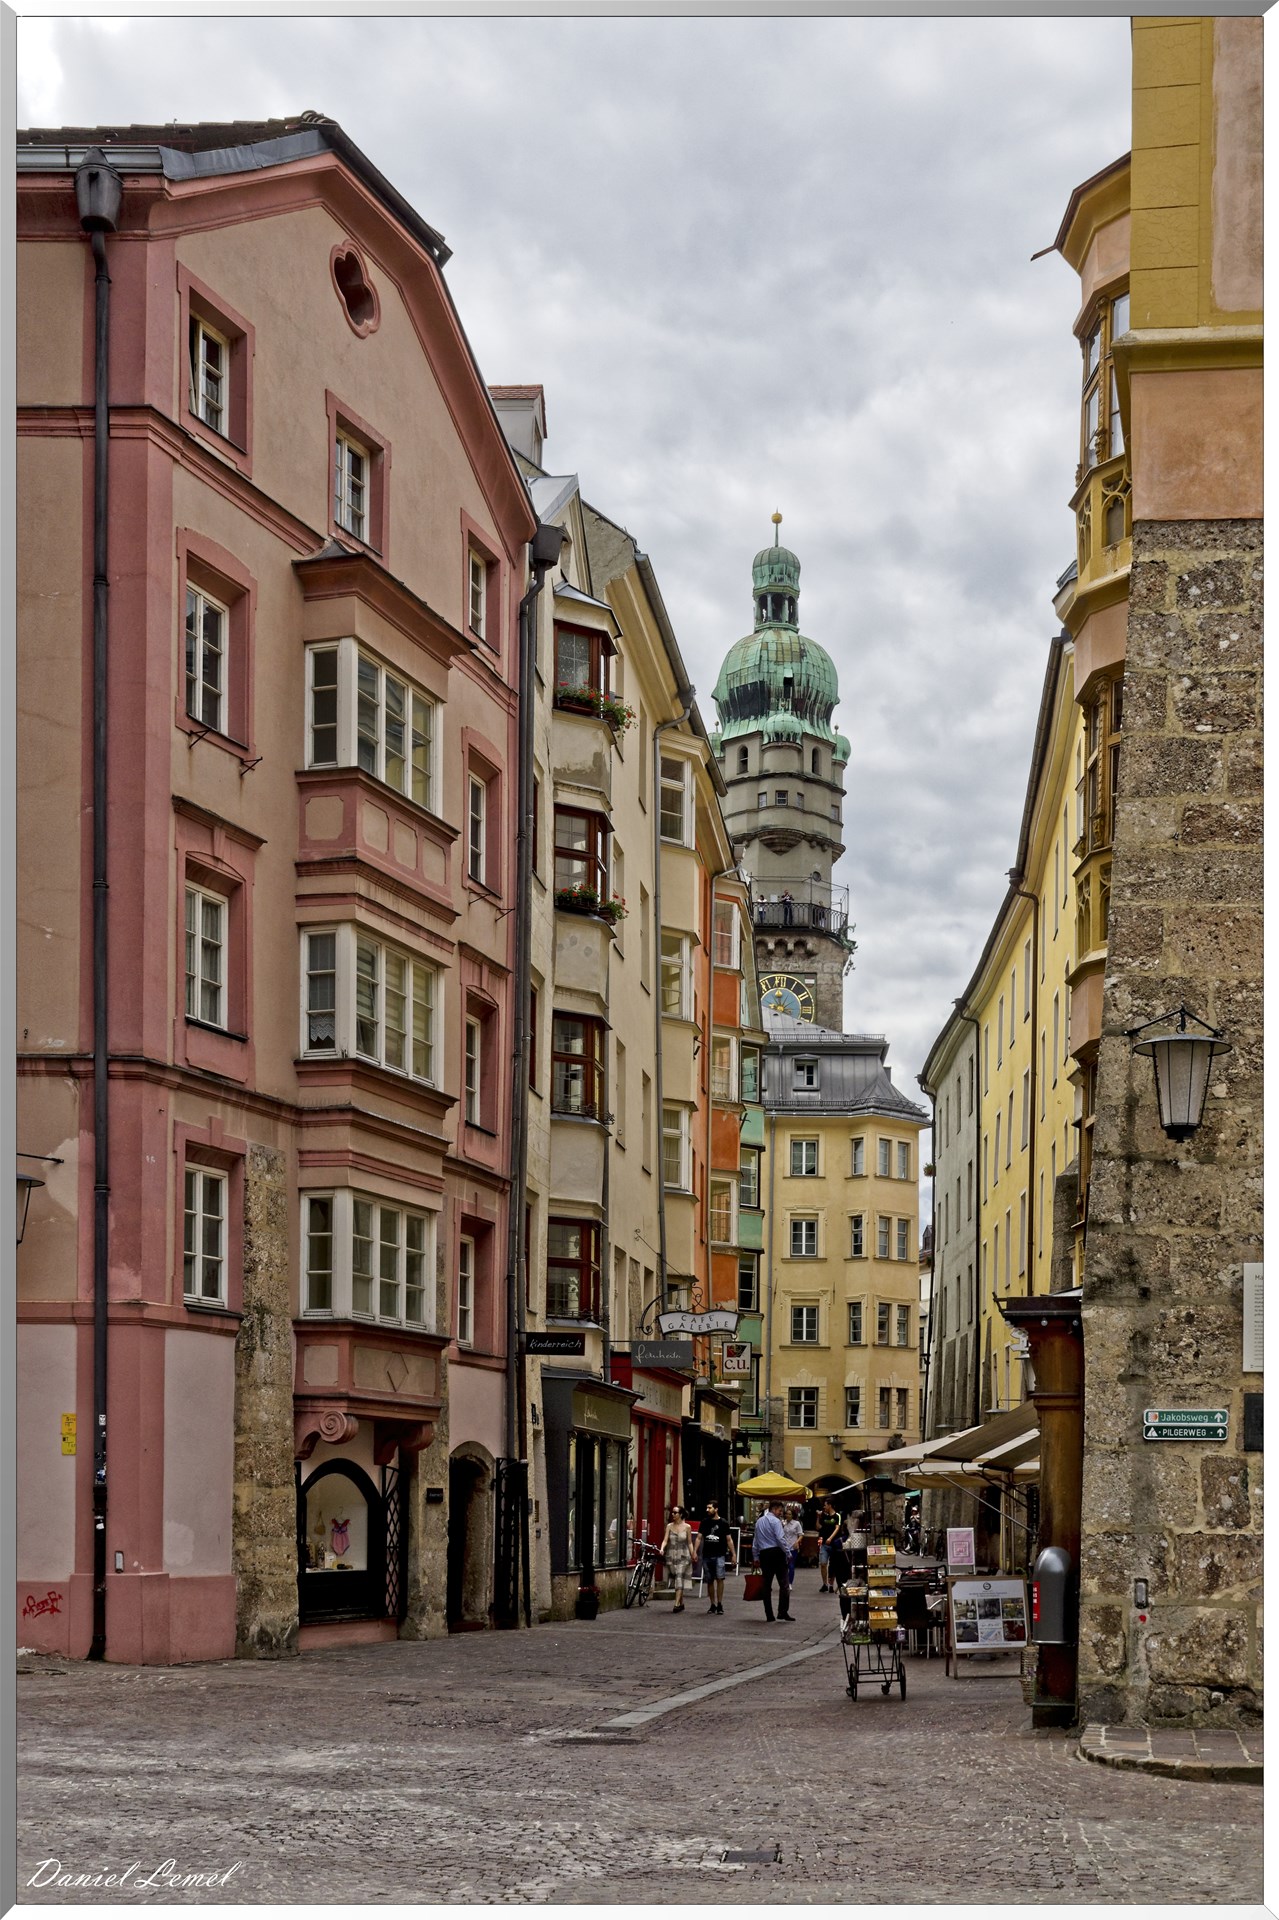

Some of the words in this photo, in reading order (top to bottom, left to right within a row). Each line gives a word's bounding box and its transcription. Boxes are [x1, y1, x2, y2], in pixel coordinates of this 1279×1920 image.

[668, 1321, 728, 1331] GALERIE
[1161, 1413, 1209, 1423] Jakobsweg
[1162, 1428, 1207, 1437] PILGERWEG
